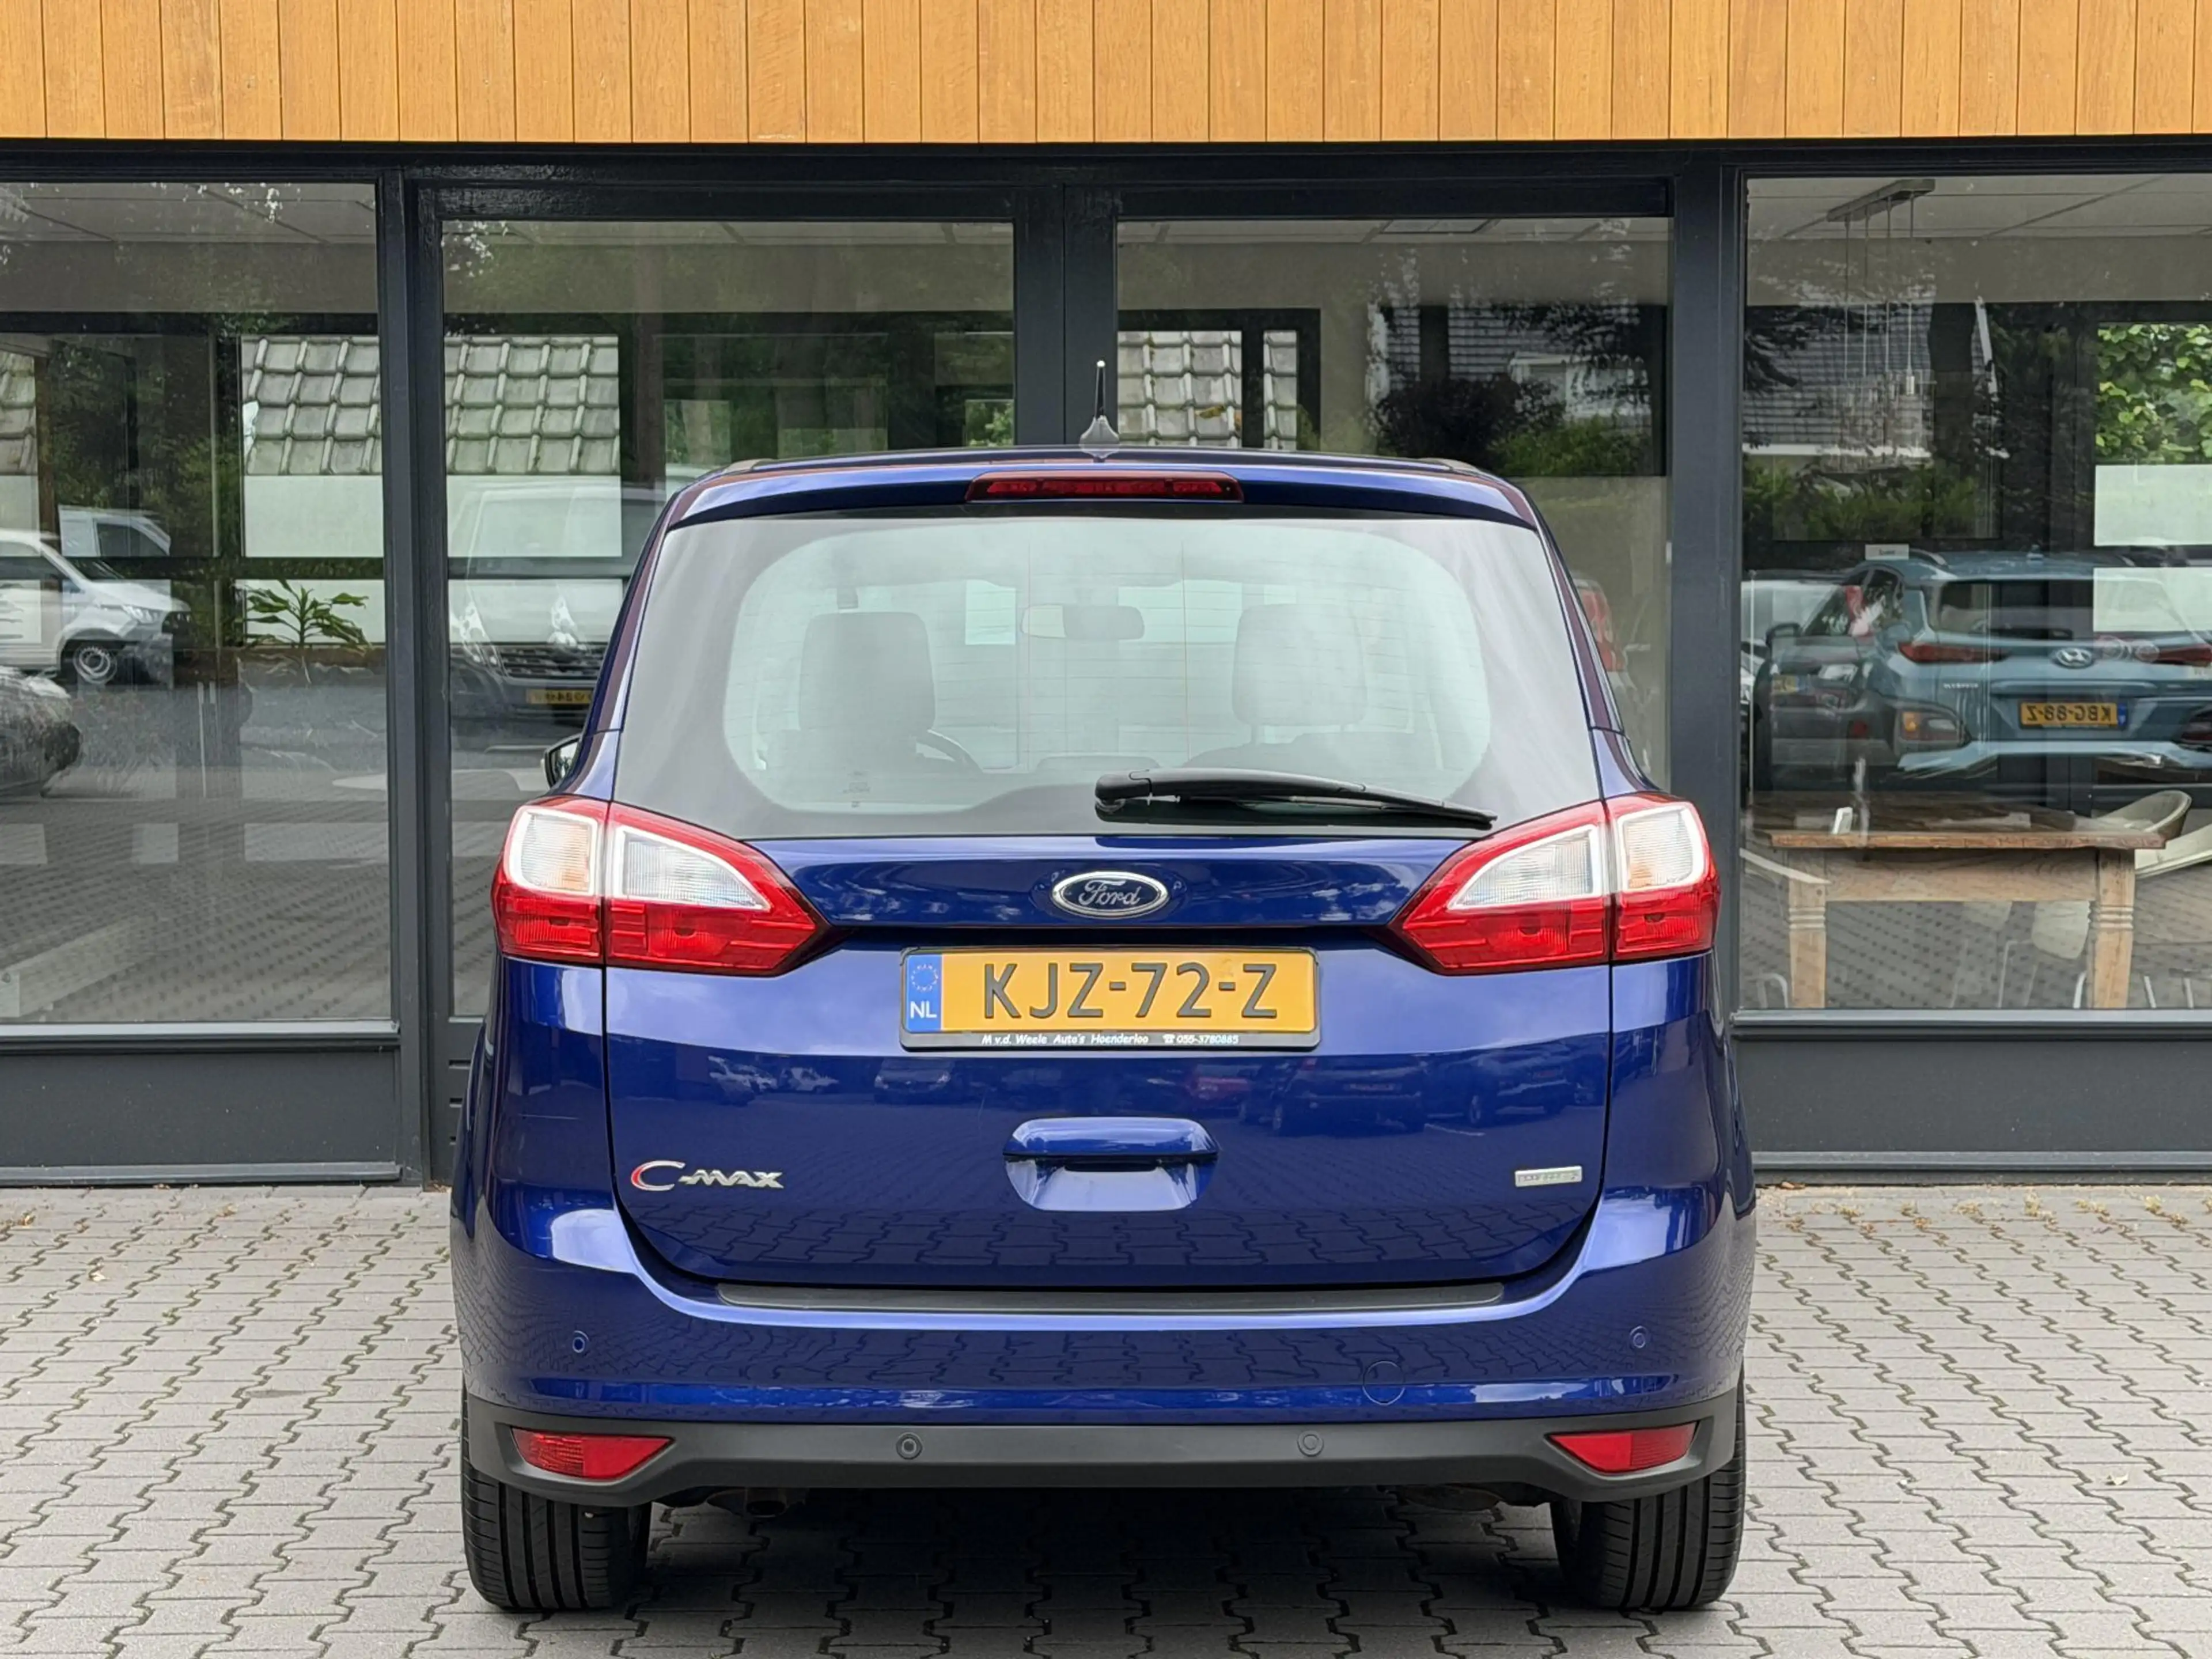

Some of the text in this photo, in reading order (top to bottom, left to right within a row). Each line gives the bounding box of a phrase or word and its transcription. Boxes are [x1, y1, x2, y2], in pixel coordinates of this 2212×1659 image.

[1078, 879, 1142, 906] Ford
[984, 963, 1278, 1019] KJZ-72-Z
[910, 1001, 938, 1020] NL
[1053, 1033, 1086, 1045] Auto's
[1090, 1033, 1149, 1046] Hoenderloo
